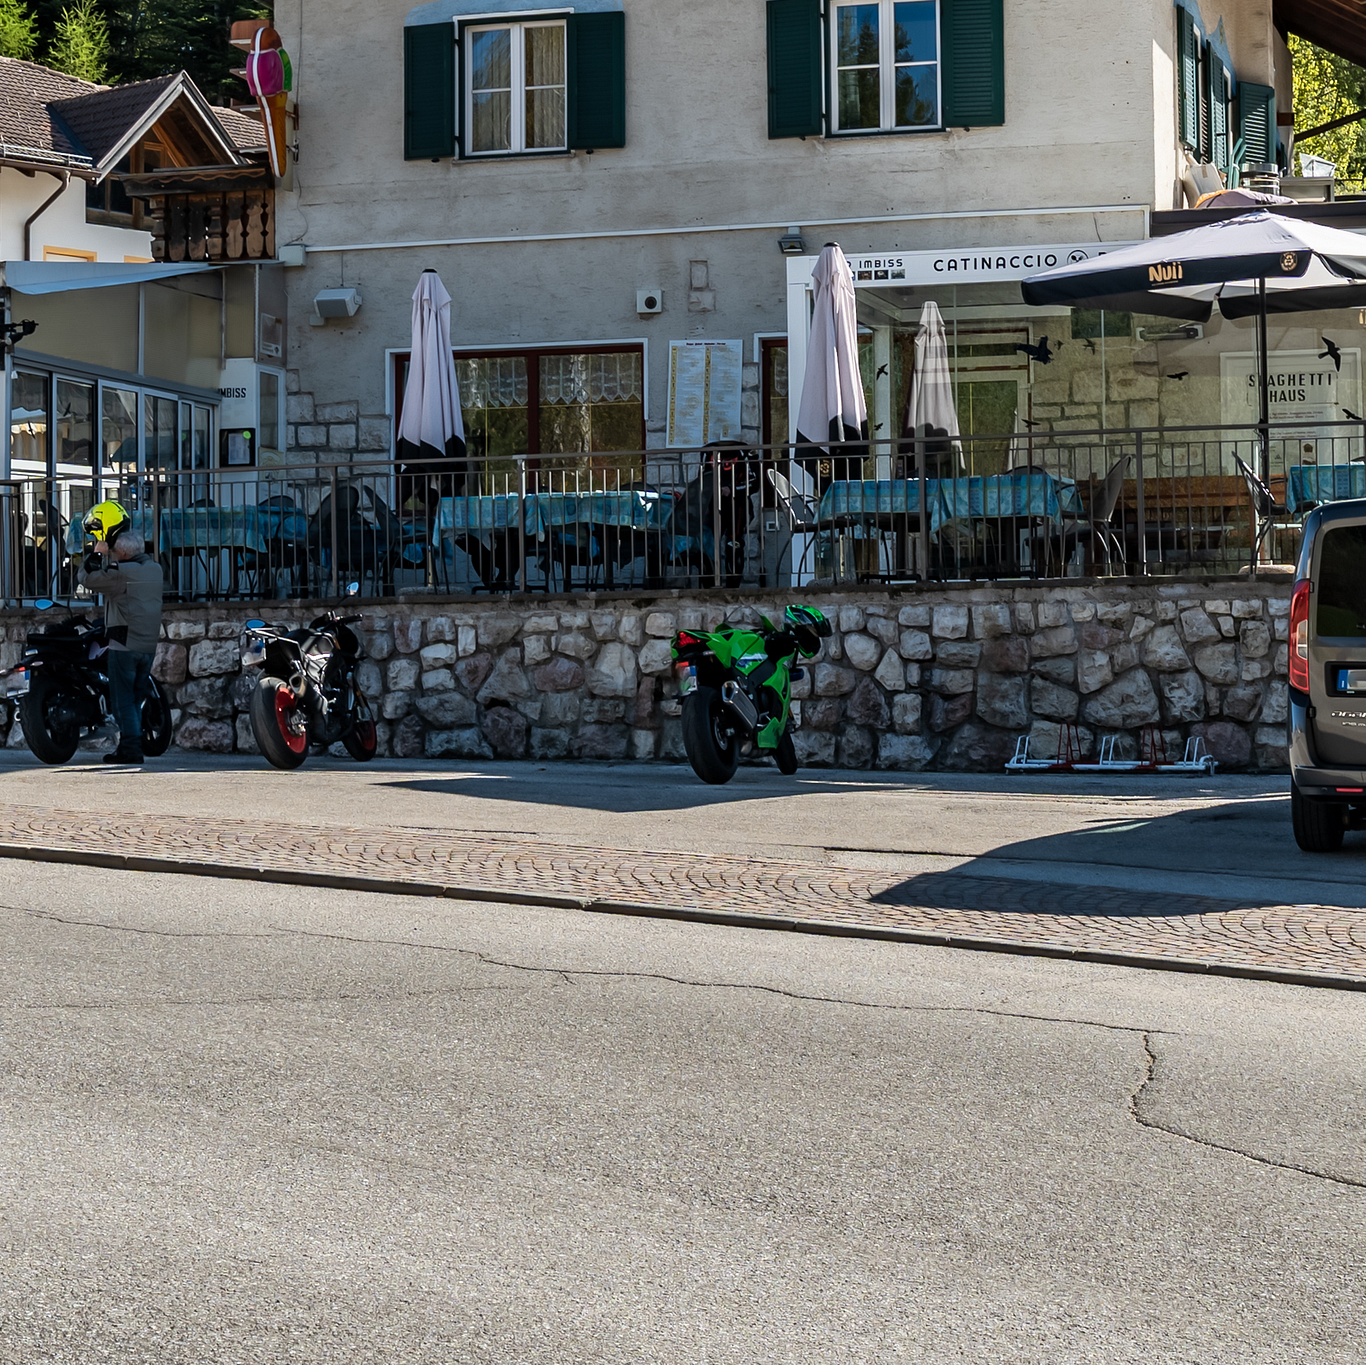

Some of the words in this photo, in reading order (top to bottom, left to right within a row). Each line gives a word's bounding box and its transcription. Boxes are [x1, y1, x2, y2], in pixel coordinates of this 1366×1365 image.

[860, 258, 903, 269] IMBISS
[934, 254, 1057, 272] CATINACCIO
[1148, 262, 1183, 282] Nuii
[1249, 373, 1332, 386] SAGHETTI
[219, 388, 246, 398] MBISS
[1270, 390, 1306, 402] HAUS
